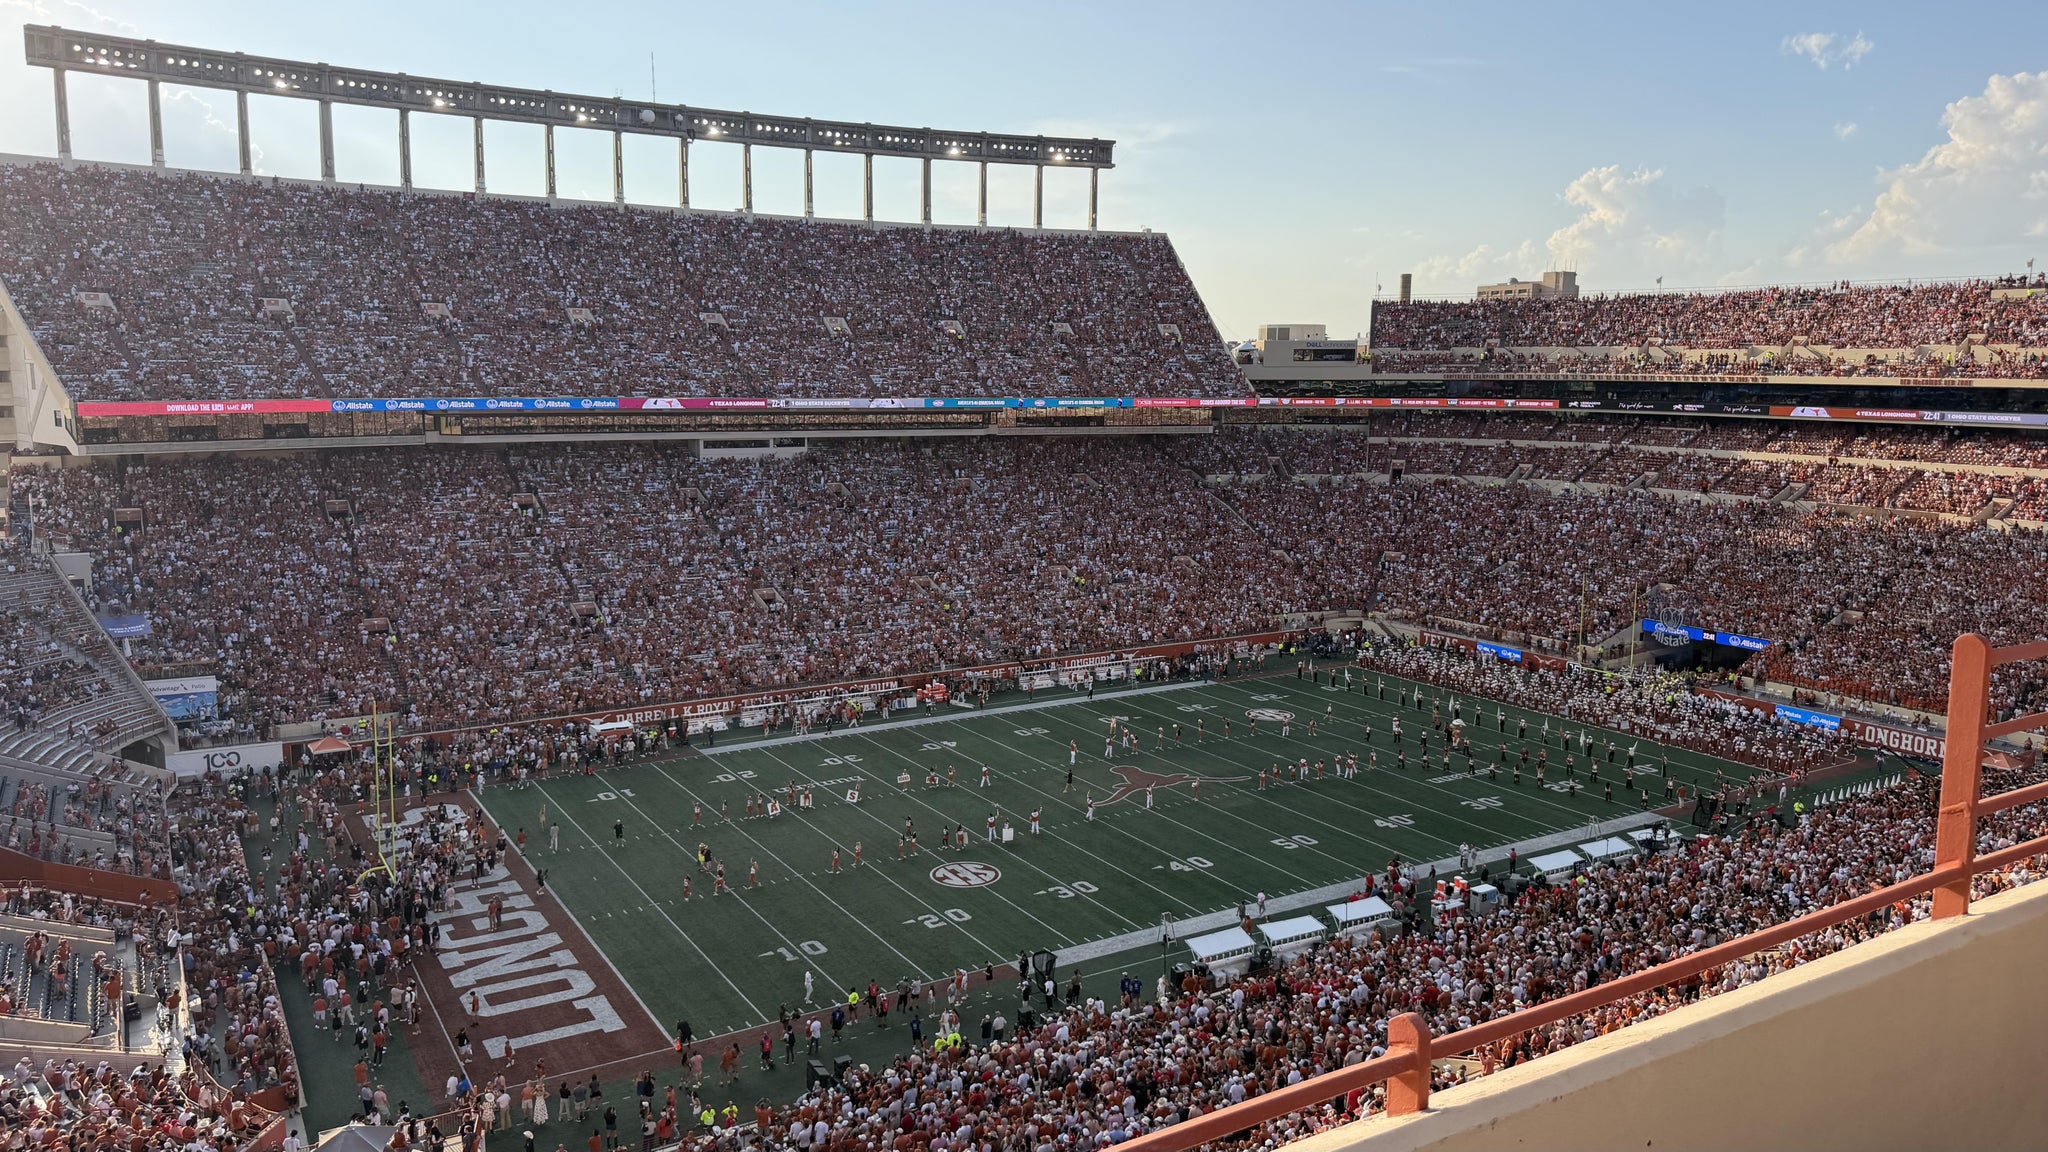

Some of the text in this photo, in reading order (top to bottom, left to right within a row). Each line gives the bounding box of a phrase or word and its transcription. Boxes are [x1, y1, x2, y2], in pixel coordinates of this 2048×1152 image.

[166, 404, 199, 412] DOWNLOAD
[346, 402, 374, 410] Allstate
[399, 401, 424, 409] Allstate
[449, 400, 476, 408] Allstate
[1924, 412, 1940, 420] 22:41
[1651, 629, 1690, 647] Allstate
[1740, 640, 1766, 650] Allstat
[992, 668, 1005, 679] OF
[616, 708, 679, 724] DARREL
[683, 706, 692, 716] K
[1820, 718, 1838, 727] Allstate
[716, 770, 758, 782] 20
[596, 788, 636, 800] 10
[848, 792, 857, 800] S
[1460, 798, 1504, 811] 30
[1374, 814, 1415, 829] 40
[1270, 834, 1318, 850] 50
[1169, 856, 1214, 873] 40
[1048, 880, 1099, 899] 30
[918, 908, 972, 930] 20
[776, 940, 828, 962] 10
